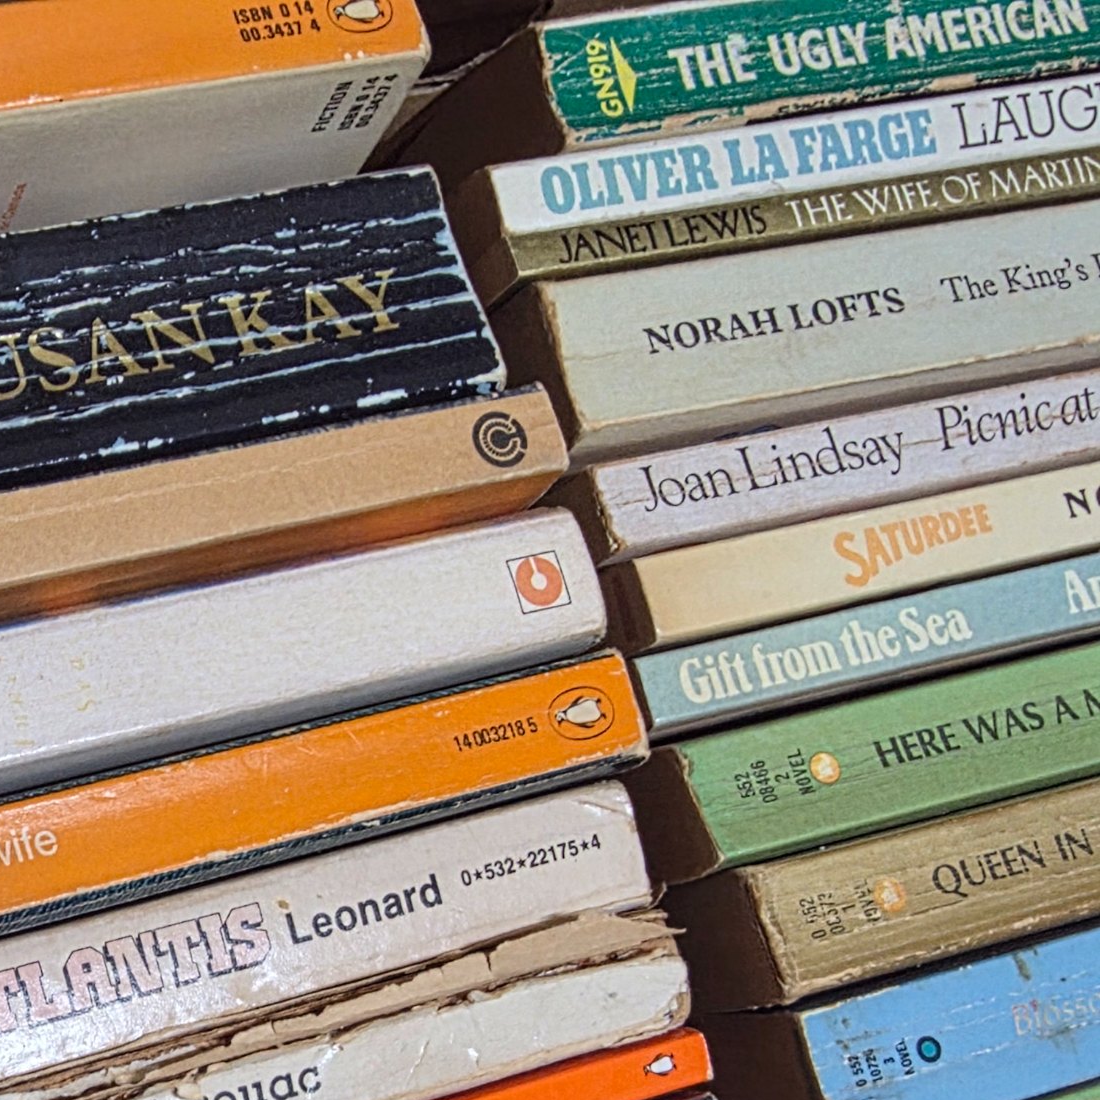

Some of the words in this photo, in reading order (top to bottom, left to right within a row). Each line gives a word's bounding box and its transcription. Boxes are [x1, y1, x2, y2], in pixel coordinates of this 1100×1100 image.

[233, 5, 273, 24] ISBN
[280, 3, 290, 18] 0
[295, 0, 314, 16] 14
[240, 21, 302, 42] 00.3437
[310, 19, 321, 32] 4
[668, 35, 758, 91] THE
[767, 24, 881, 76] UGLY
[884, 0, 1090, 57] AMERICAN
[585, 39, 624, 117] GN919
[311, 81, 353, 132] FICTION
[337, 104, 363, 130] ISBN
[951, 82, 1100, 150] LAUG
[541, 144, 719, 215] OLIVER
[723, 134, 790, 186] LA
[788, 109, 938, 175] FARGE
[785, 192, 853, 228] THE
[852, 180, 939, 216] WIFE
[941, 172, 981, 204] OF
[560, 219, 658, 265] JANET
[663, 205, 767, 249] LEWIS
[940, 275, 999, 303] The
[999, 258, 1090, 294] King's
[225, 270, 401, 357] KAY
[643, 307, 784, 355] NORAH
[793, 288, 906, 330] LOFTS
[936, 392, 1053, 452] Picnic
[1060, 386, 1096, 426] at
[639, 463, 737, 513] Joan
[738, 427, 904, 493] Lindsay
[833, 504, 993, 588] SATURDEE
[679, 642, 753, 703] Gift
[751, 632, 841, 689] from
[840, 620, 901, 667] the
[900, 605, 973, 654] Sea
[873, 722, 962, 768] HERE
[962, 701, 1045, 744] WAS
[1055, 695, 1080, 725] A
[734, 772, 756, 798] 552
[750, 760, 778, 803] 08466
[774, 772, 790, 783] 2
[788, 748, 816, 795] NOVEL
[932, 841, 1046, 898] QUEEN
[1054, 828, 1094, 861] IN
[284, 873, 443, 946] Leonard
[811, 929, 827, 939] 0
[841, 903, 856, 913] 1
[847, 1055, 864, 1076] 552
[884, 1057, 896, 1065] 3
[896, 1038, 915, 1075] NOVEL
[856, 1079, 868, 1088] 0
